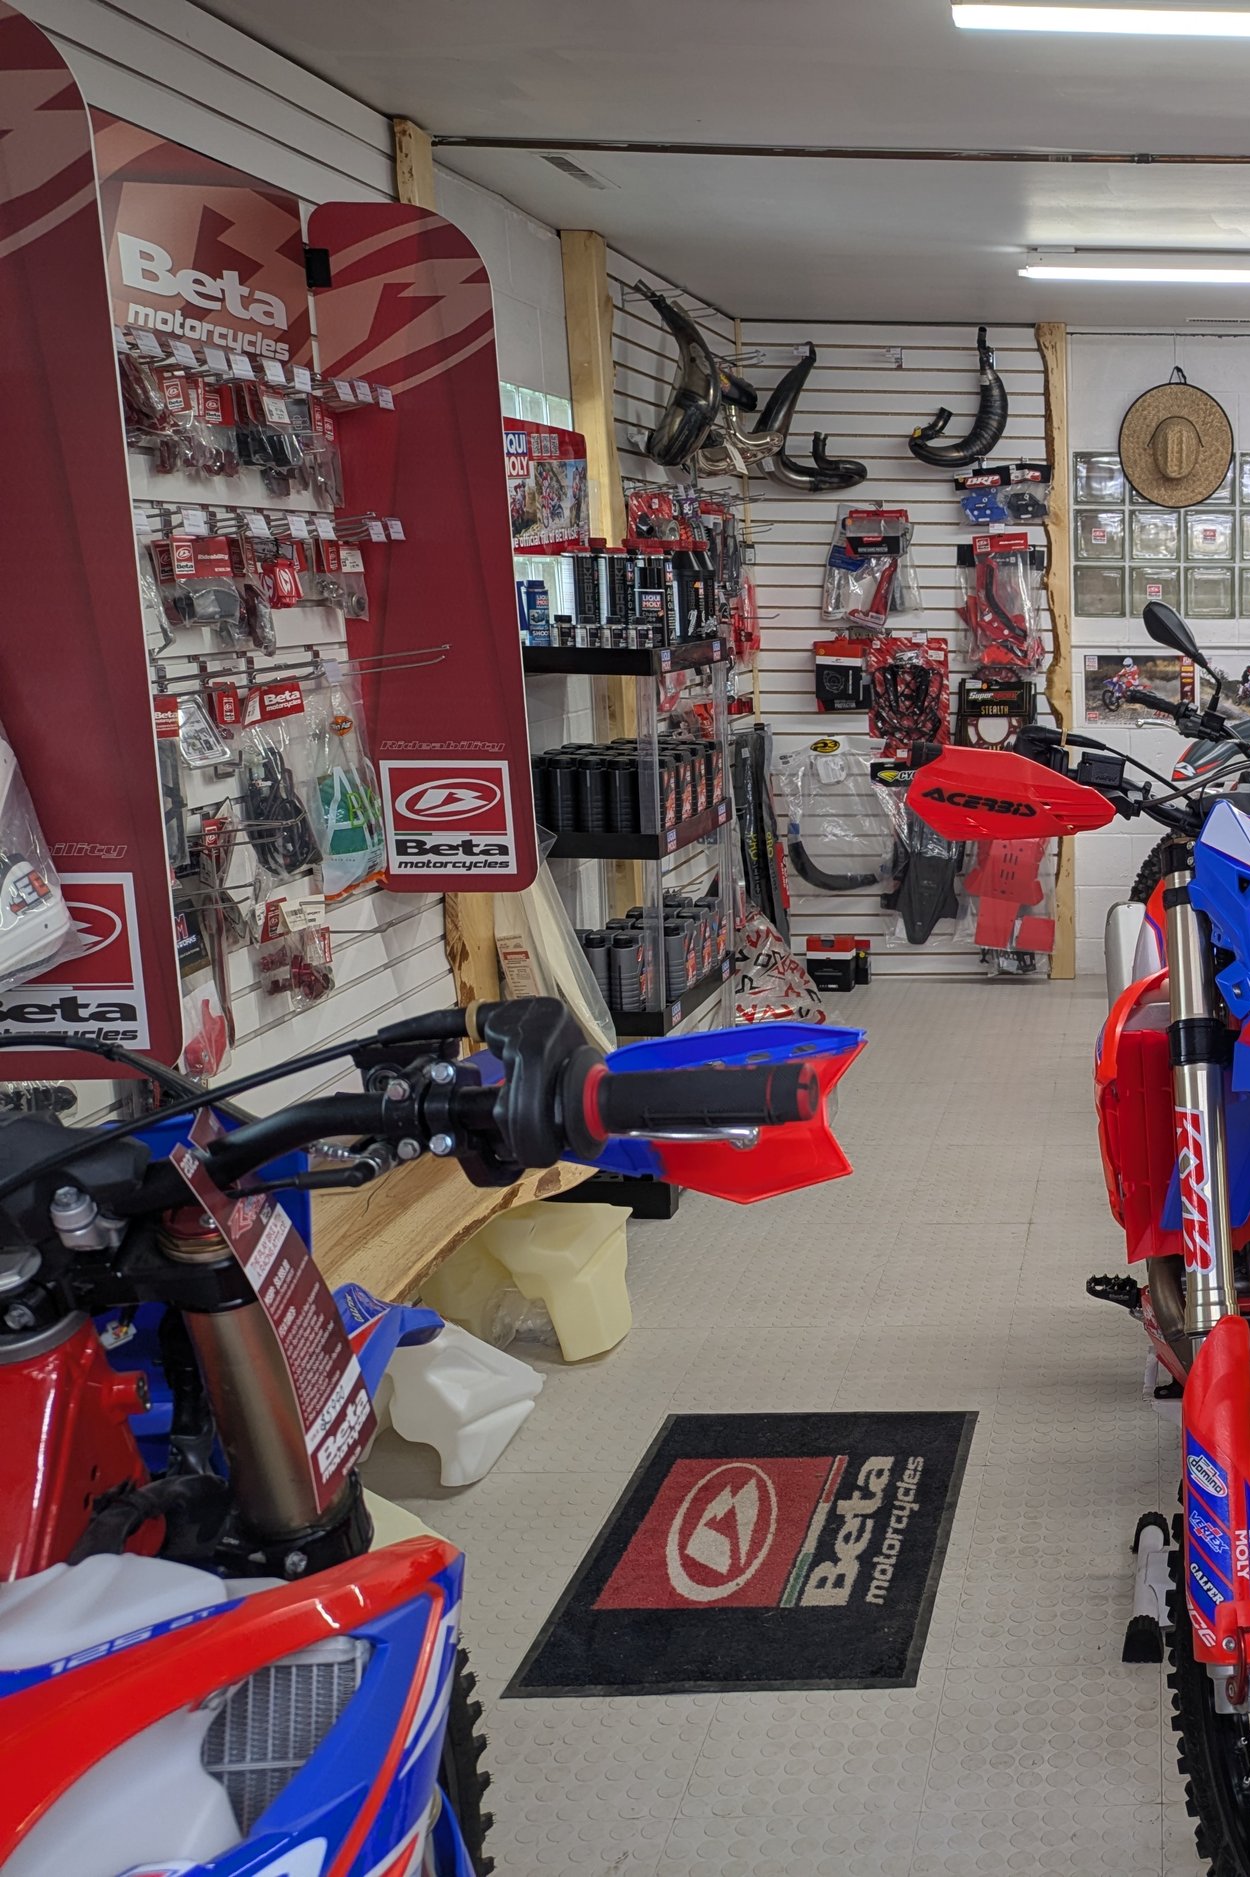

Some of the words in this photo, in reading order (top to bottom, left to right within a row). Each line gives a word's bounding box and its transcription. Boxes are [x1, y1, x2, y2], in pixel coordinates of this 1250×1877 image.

[117, 232, 288, 331] Beta
[127, 302, 290, 361] motorcycles
[264, 690, 301, 706] Beta
[981, 705, 1009, 715] STEALTH
[380, 741, 506, 752] Rideability
[922, 787, 1037, 817] ACERBIS
[395, 839, 510, 857] Beta
[397, 859, 510, 871] motorcycles
[317, 1388, 369, 1475] Beta
[1190, 1456, 1224, 1494] domino
[801, 1456, 895, 1606] Beta
[866, 1456, 925, 1605] motorcycles
[1190, 1510, 1230, 1554] VERTEX
[1235, 1529, 1250, 1580] MOLY
[1189, 1562, 1225, 1605] GALFER
[50, 1625, 155, 1676] 125
